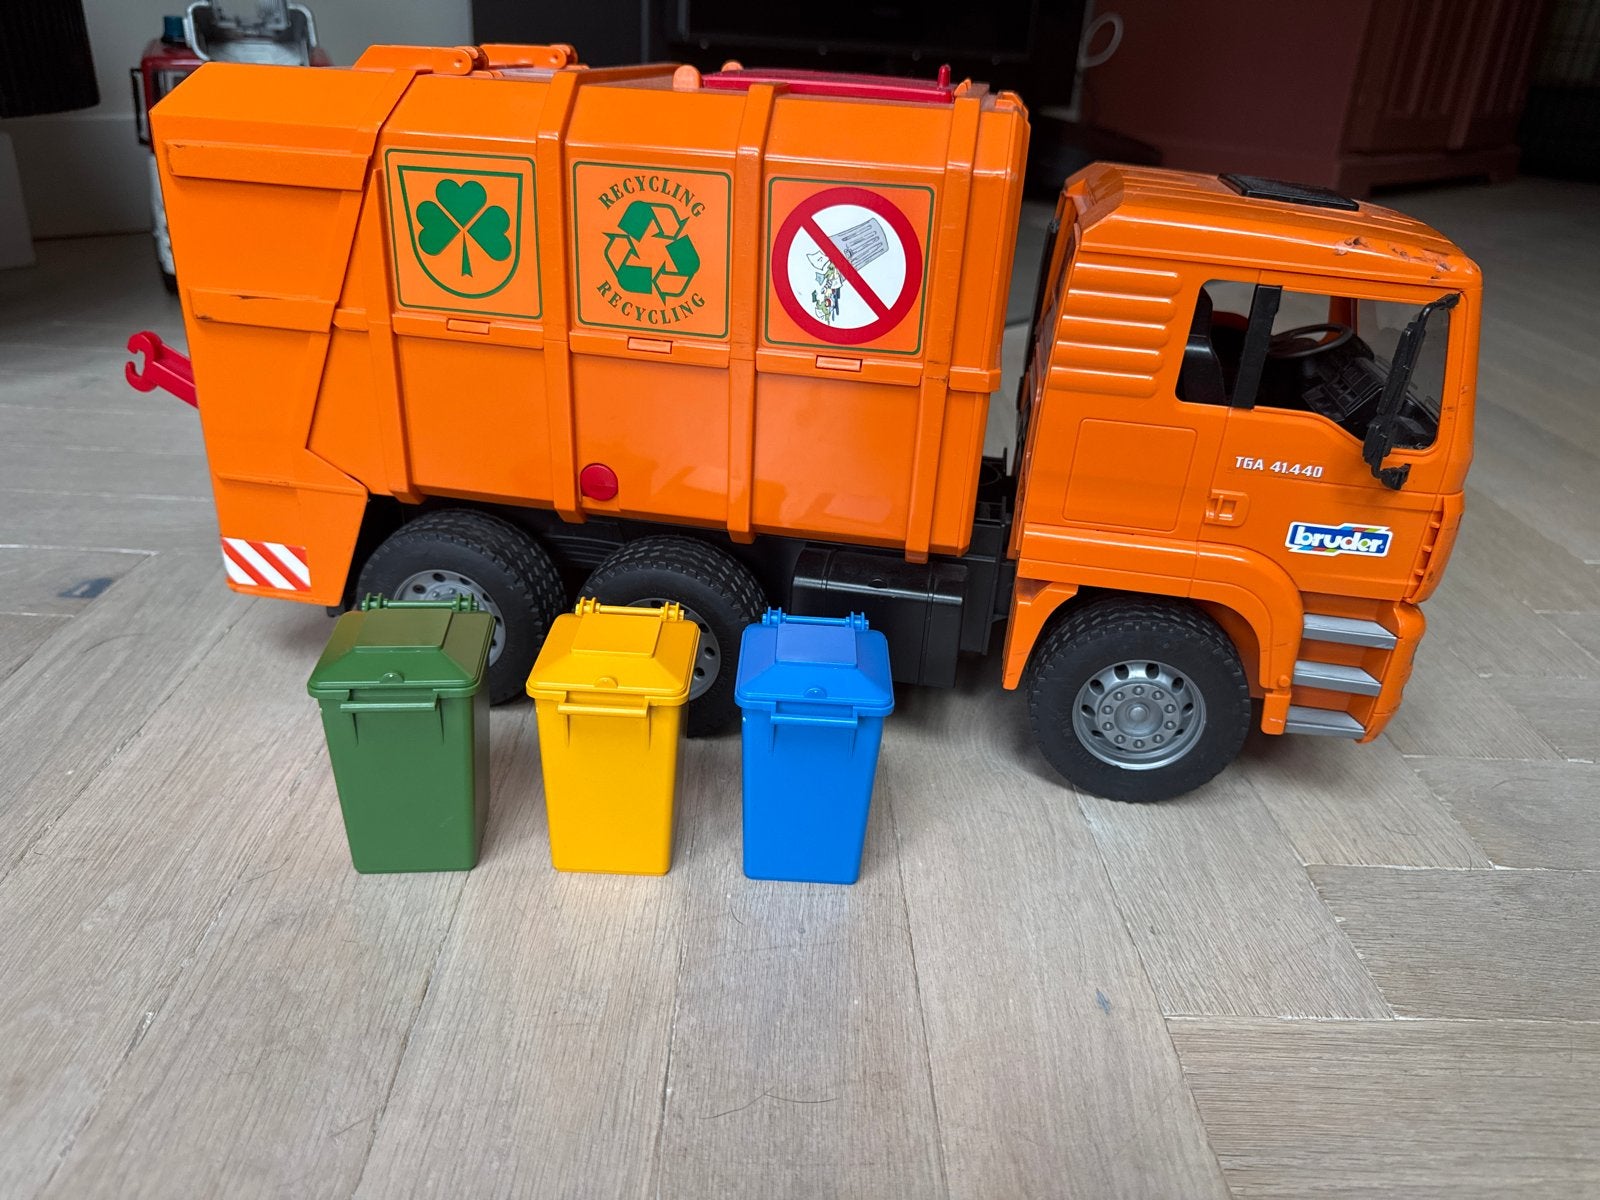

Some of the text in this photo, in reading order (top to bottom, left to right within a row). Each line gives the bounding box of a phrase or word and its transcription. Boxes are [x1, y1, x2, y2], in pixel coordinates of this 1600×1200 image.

[598, 175, 706, 218] RECYCLING
[596, 280, 705, 325] RECYCLING
[1235, 456, 1323, 478] TGA 41.440
[1294, 526, 1383, 553] bruder
